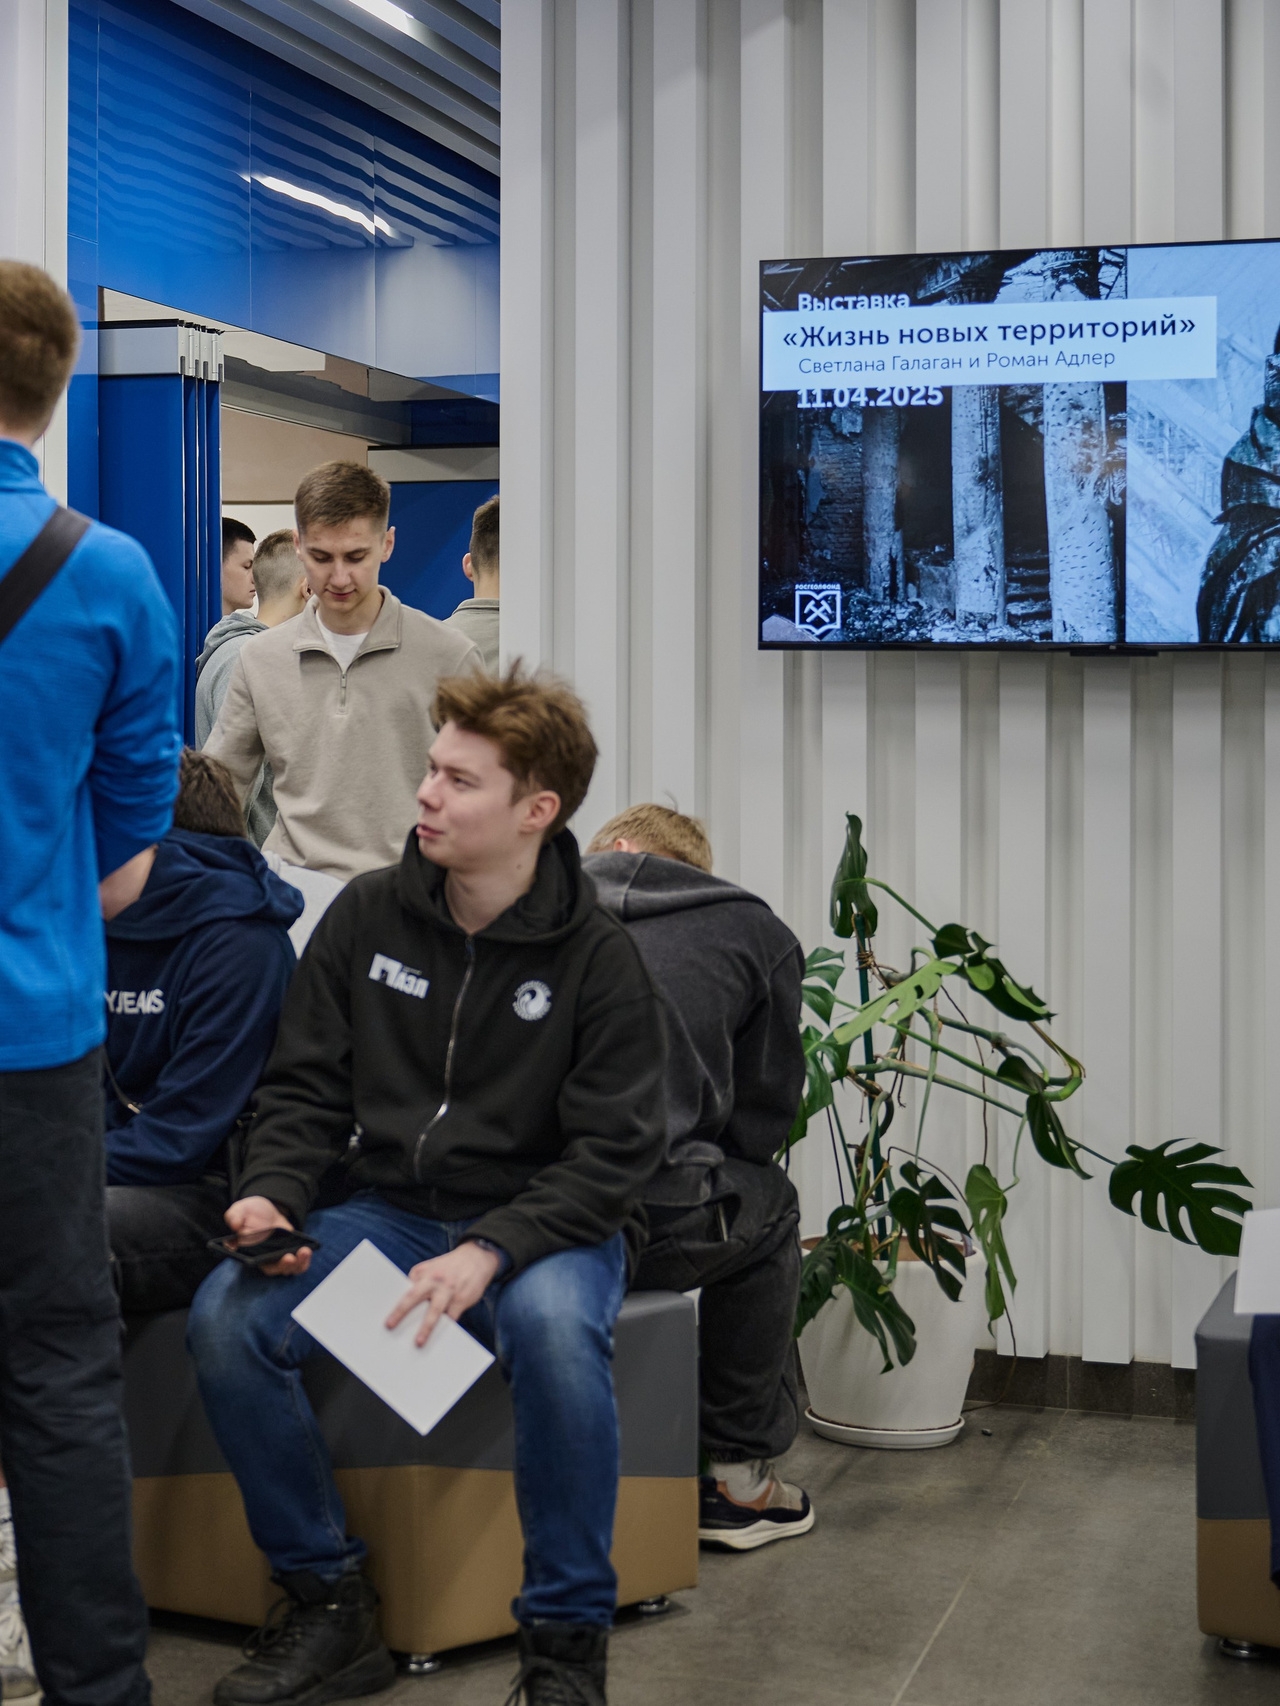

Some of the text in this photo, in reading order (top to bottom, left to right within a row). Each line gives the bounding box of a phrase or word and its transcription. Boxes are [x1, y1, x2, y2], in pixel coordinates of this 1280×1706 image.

[798, 293, 910, 311] Выставка
[783, 314, 1196, 347] «Жизнь новых территорий»
[798, 351, 1116, 374] Светлана Галаган и Роман Адлер
[796, 386, 944, 409] 11.04.2025
